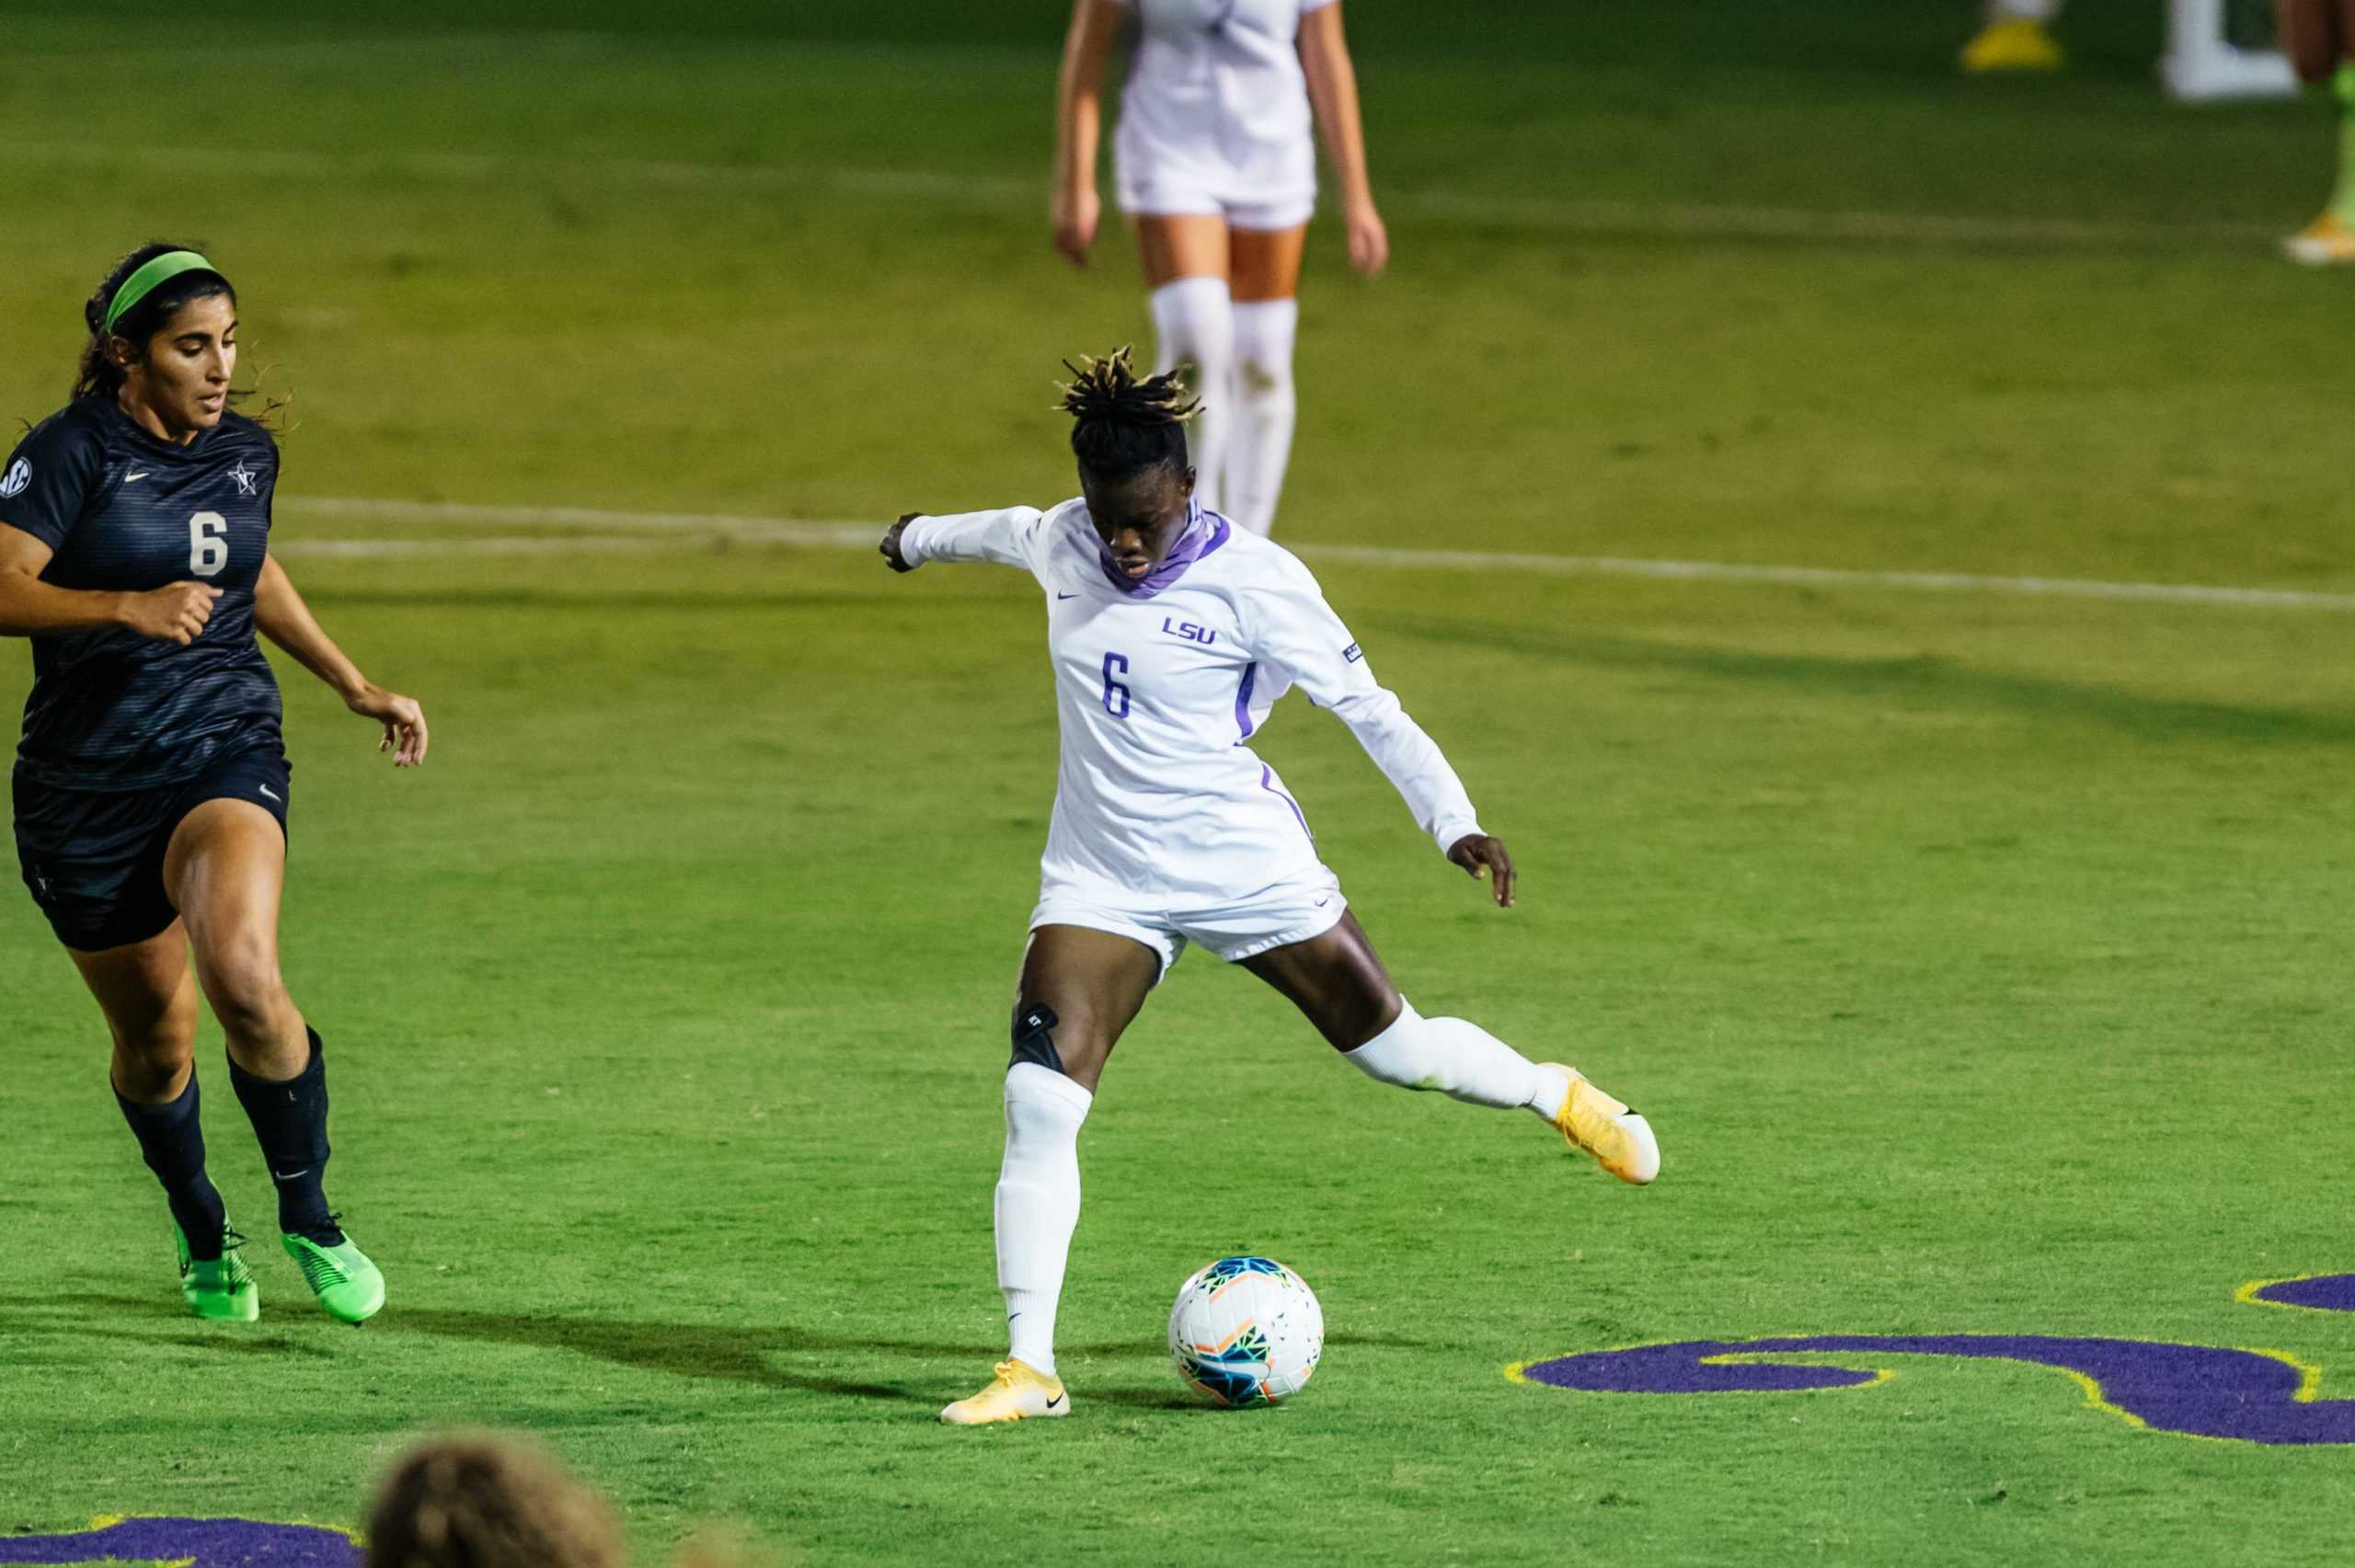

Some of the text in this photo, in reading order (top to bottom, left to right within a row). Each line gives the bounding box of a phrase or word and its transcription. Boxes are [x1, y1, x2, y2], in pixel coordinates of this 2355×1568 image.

[190, 510, 228, 576] 6
[1162, 616, 1216, 645] LSU
[1102, 651, 1131, 719] 6
